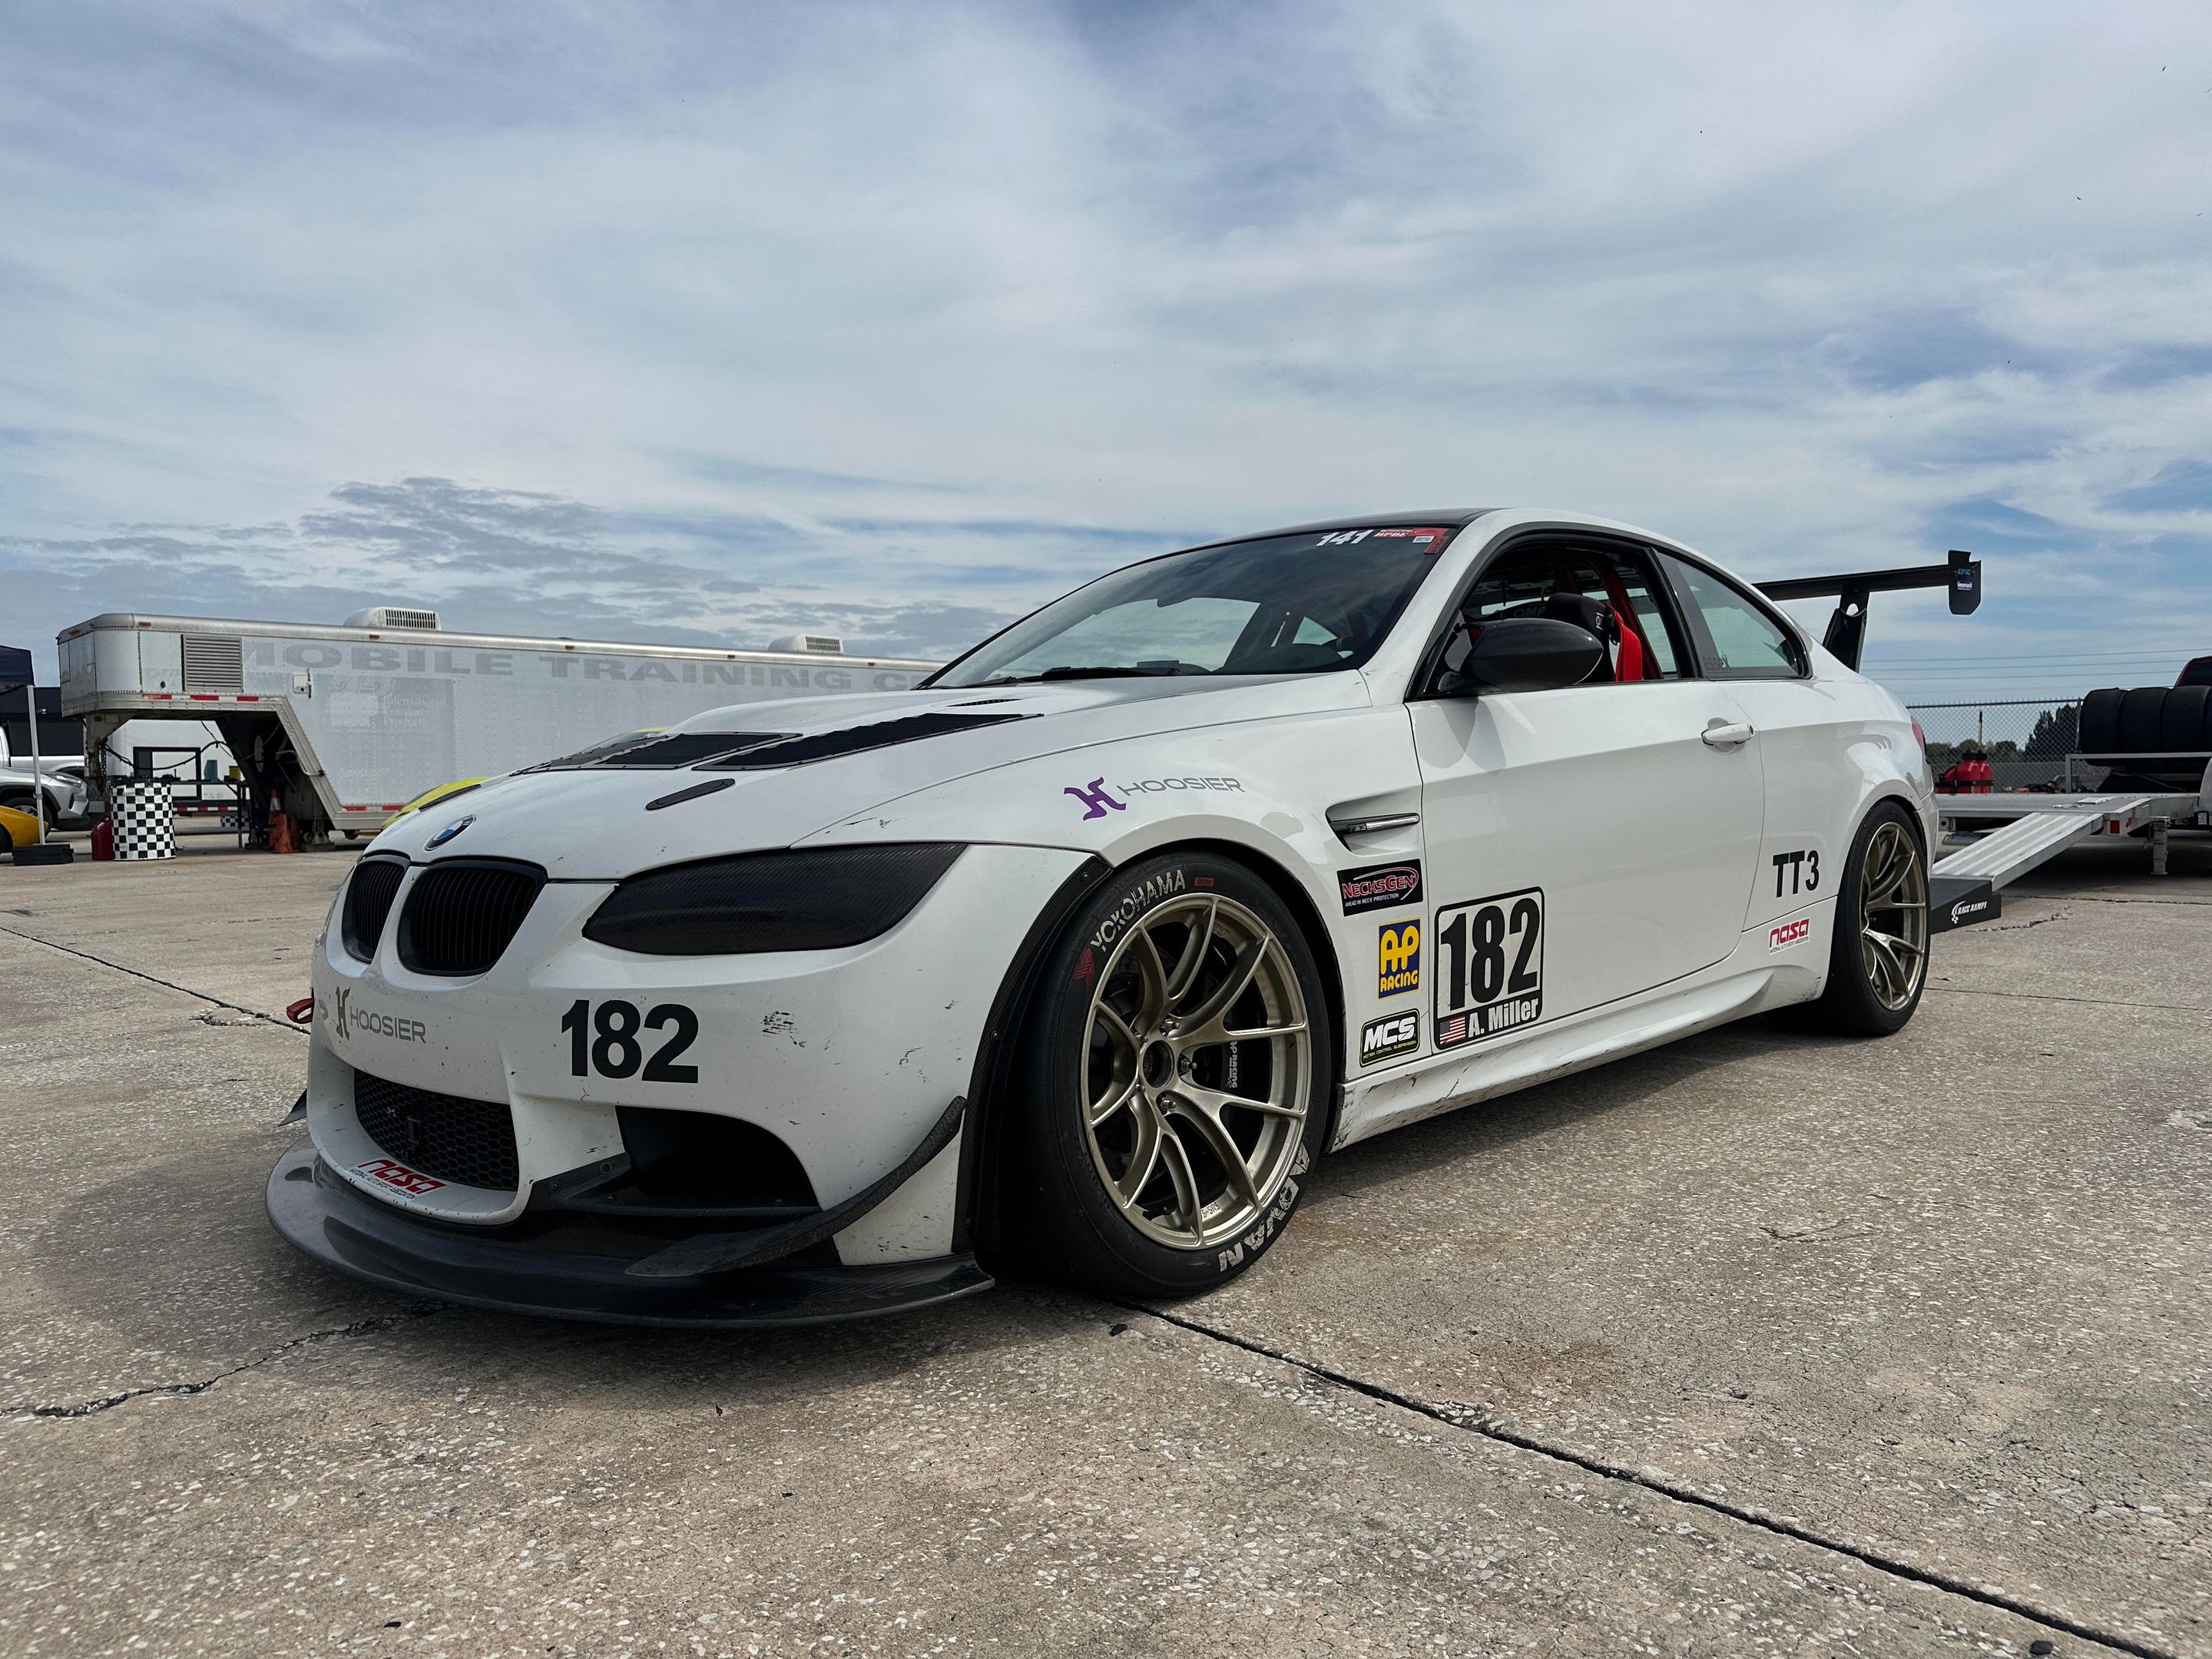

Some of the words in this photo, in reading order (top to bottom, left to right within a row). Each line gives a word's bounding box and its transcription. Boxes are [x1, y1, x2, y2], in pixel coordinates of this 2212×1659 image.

[1315, 529, 1375, 547] 141
[539, 656, 852, 690] TRAINING
[1116, 777, 1246, 796] HOOSIER
[1773, 849, 1820, 898] TT3
[1091, 869, 1186, 952] YOKOHAMA
[1373, 893, 1399, 902] PROTECTION
[1970, 901, 1988, 912] RAMPS
[1380, 925, 1419, 975] AP
[1441, 898, 1541, 1012] 182
[1380, 969, 1419, 992] RACING
[350, 1005, 427, 1045] HOOSIER
[1363, 1016, 1416, 1053] MCS
[1469, 1012, 1485, 1038] A.
[1488, 998, 1539, 1031] Miller
[561, 999, 700, 1084] 182
[1217, 1141, 1310, 1273] ADVAN
